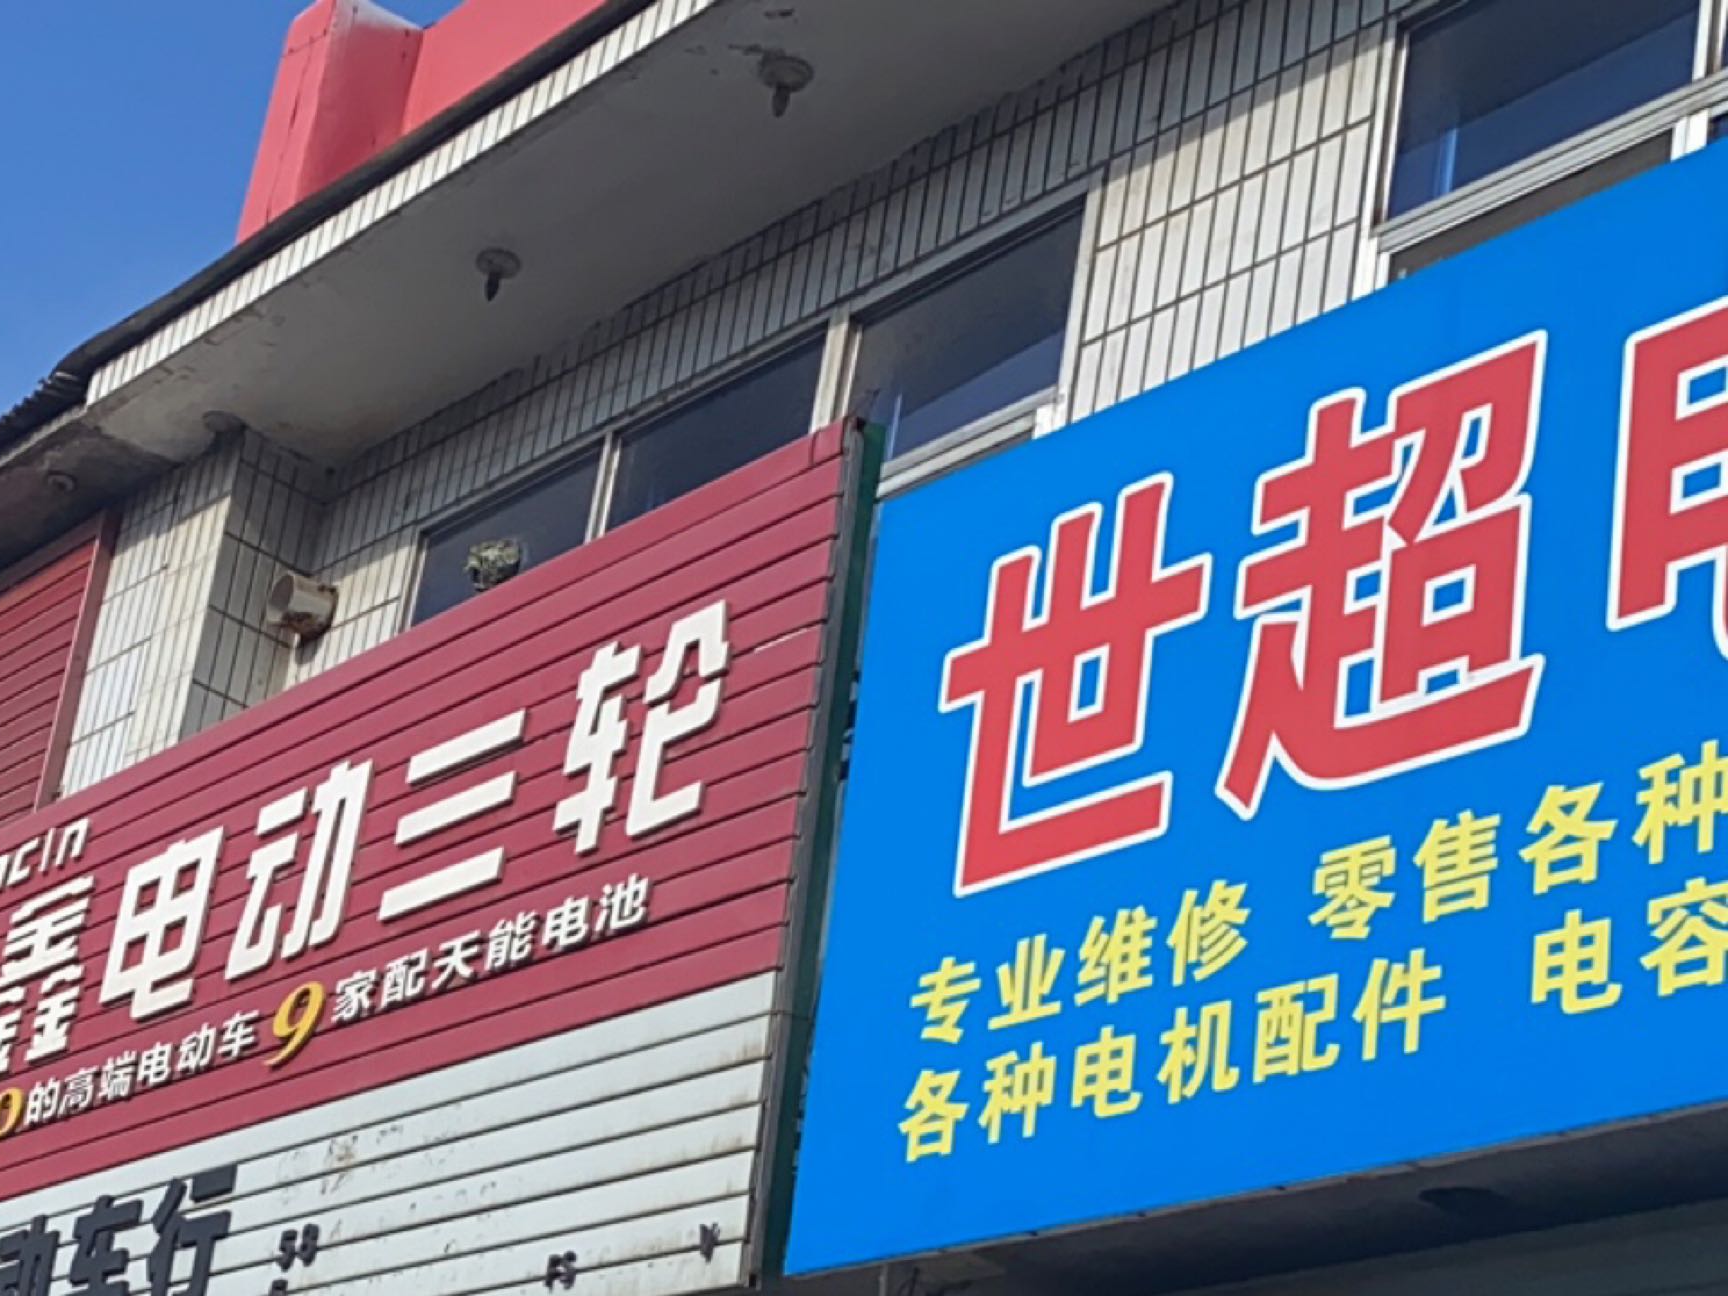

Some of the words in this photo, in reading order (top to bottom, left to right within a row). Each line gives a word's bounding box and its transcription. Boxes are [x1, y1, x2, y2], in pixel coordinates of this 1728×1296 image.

[897, 949, 1447, 1163] 各种电机配件
[1530, 877, 1728, 1017] 电容
[910, 879, 1251, 1044] 专业维修
[1307, 741, 1728, 940] 零售各种
